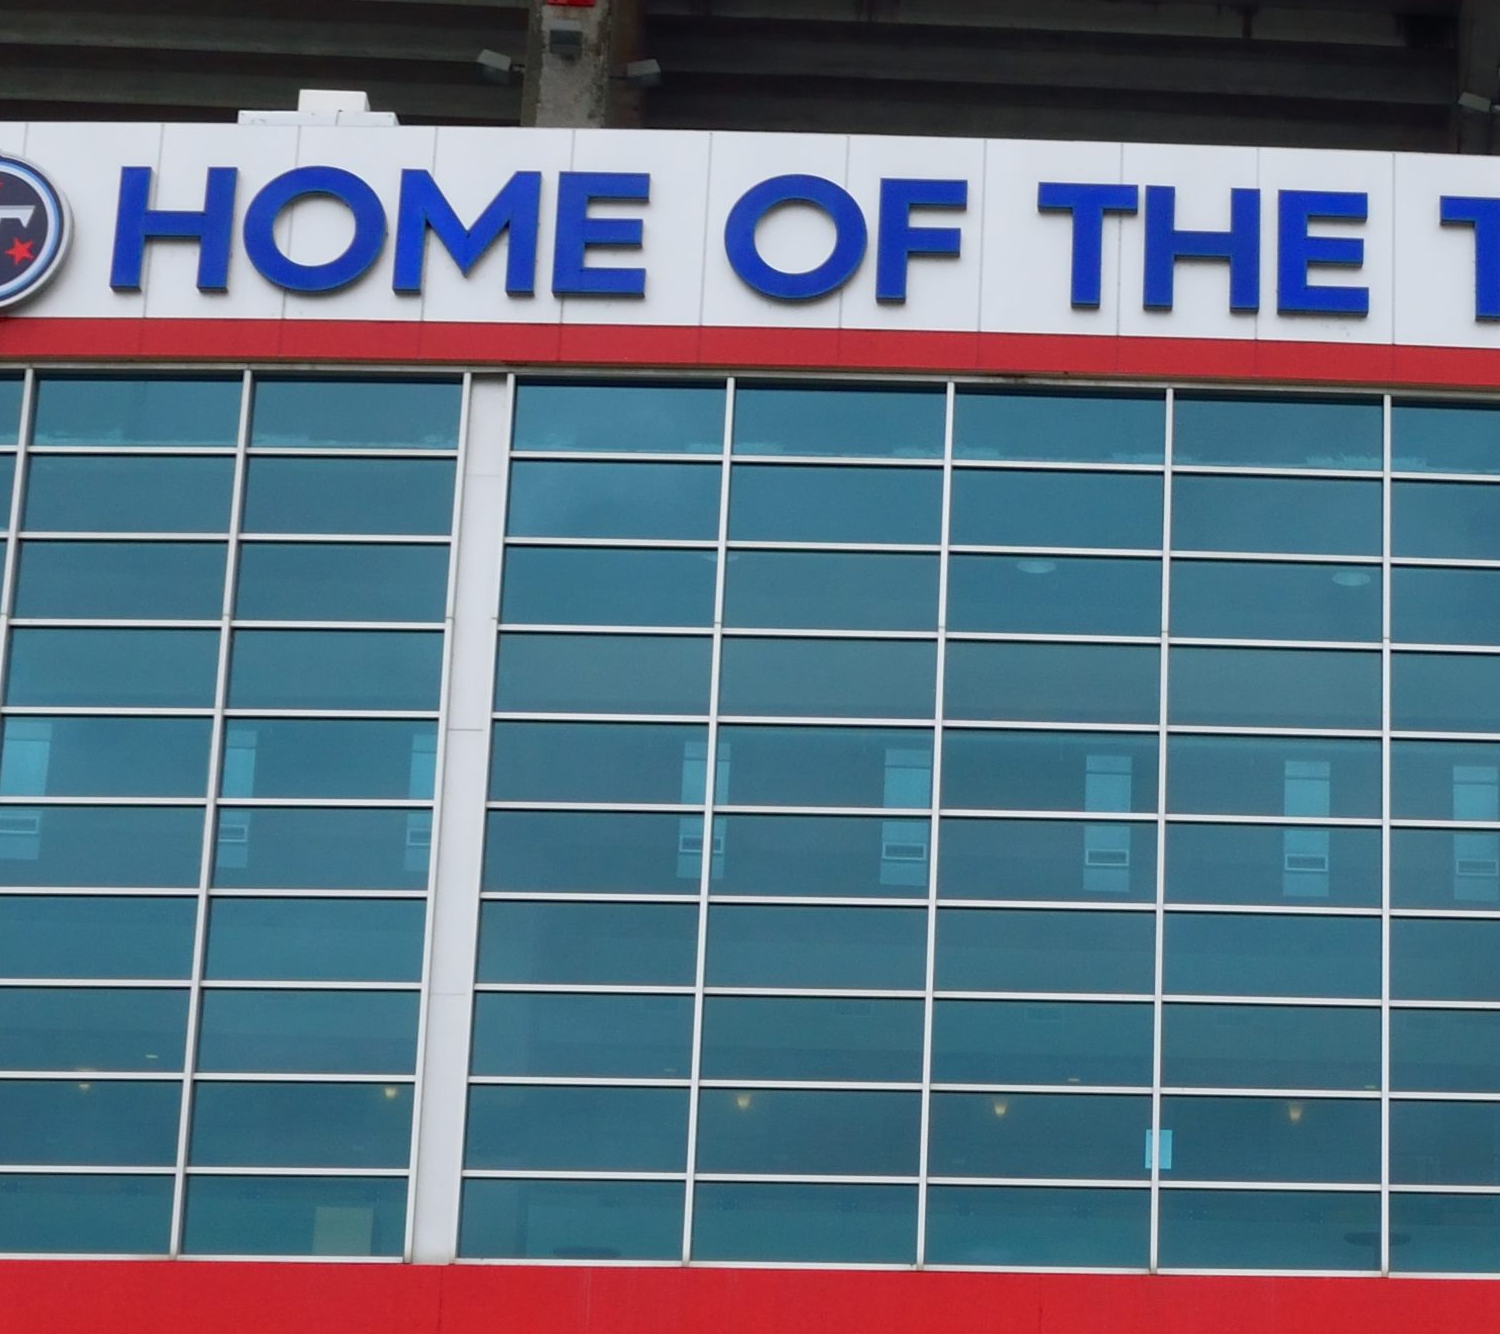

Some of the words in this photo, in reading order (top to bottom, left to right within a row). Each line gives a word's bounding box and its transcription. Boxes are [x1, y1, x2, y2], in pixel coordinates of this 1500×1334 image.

[109, 164, 652, 298] HOME
[724, 172, 970, 305] OF
[1037, 181, 1370, 316] THE
